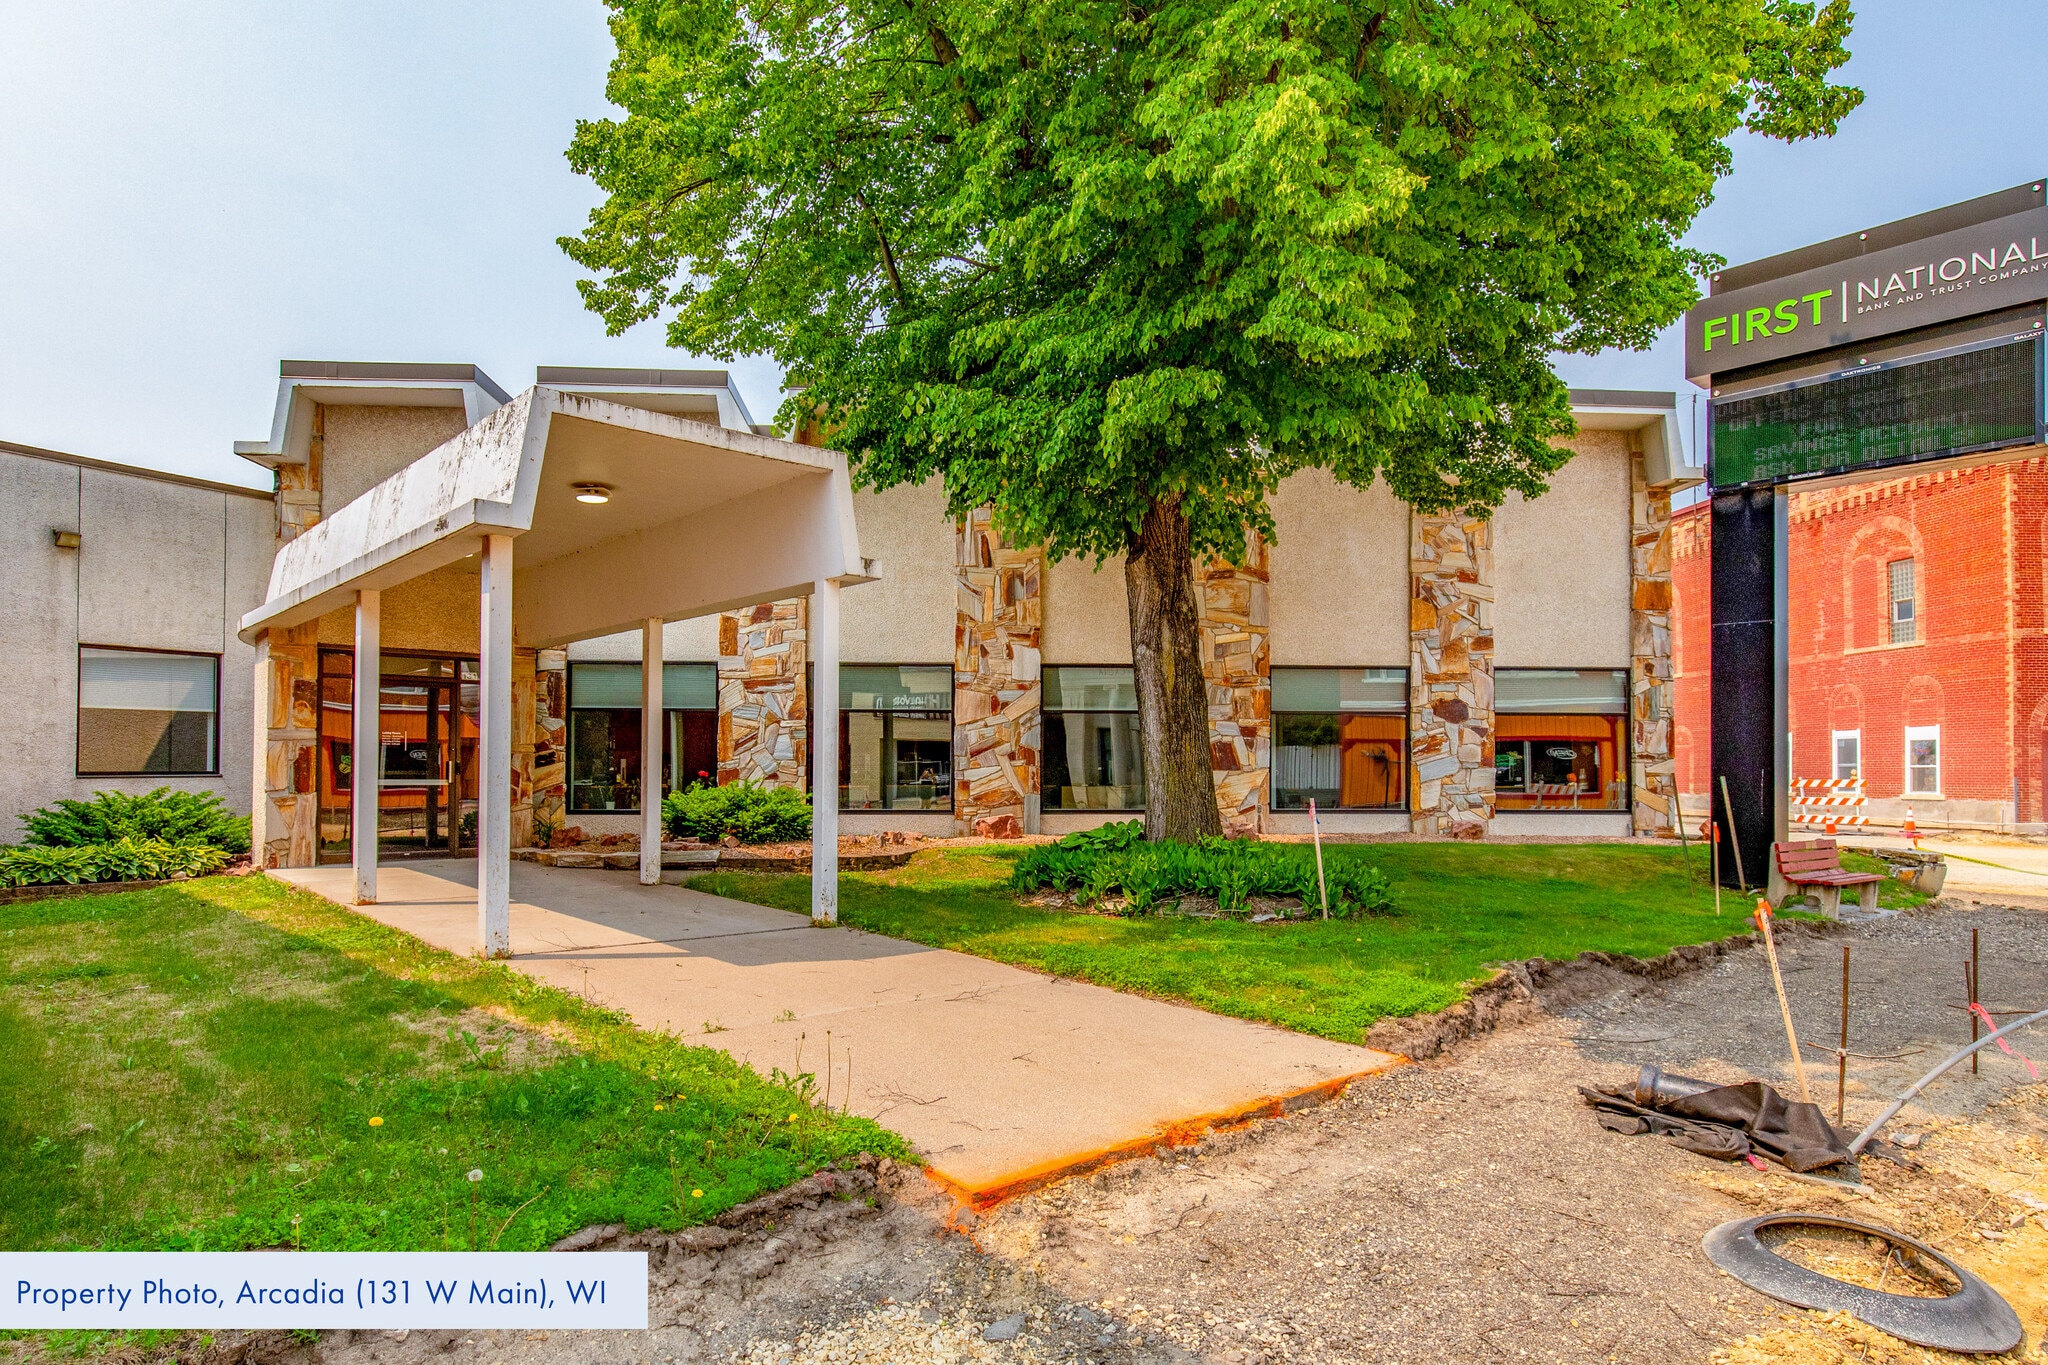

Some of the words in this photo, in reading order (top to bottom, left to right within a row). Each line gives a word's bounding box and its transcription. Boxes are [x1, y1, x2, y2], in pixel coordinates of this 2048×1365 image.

[1857, 237, 2048, 303] NATIONAL
[1857, 300, 1891, 315] BANK
[1897, 292, 1924, 306] AND
[1931, 280, 1973, 297] TRUST
[1979, 261, 2048, 285] COMPANY
[1704, 289, 1833, 352] FIRST
[1841, 364, 1881, 377] DAKTRONICS
[1753, 432, 1847, 461] SAVINGS
[1753, 459, 1795, 479] ASK
[1806, 450, 1850, 470] FOR
